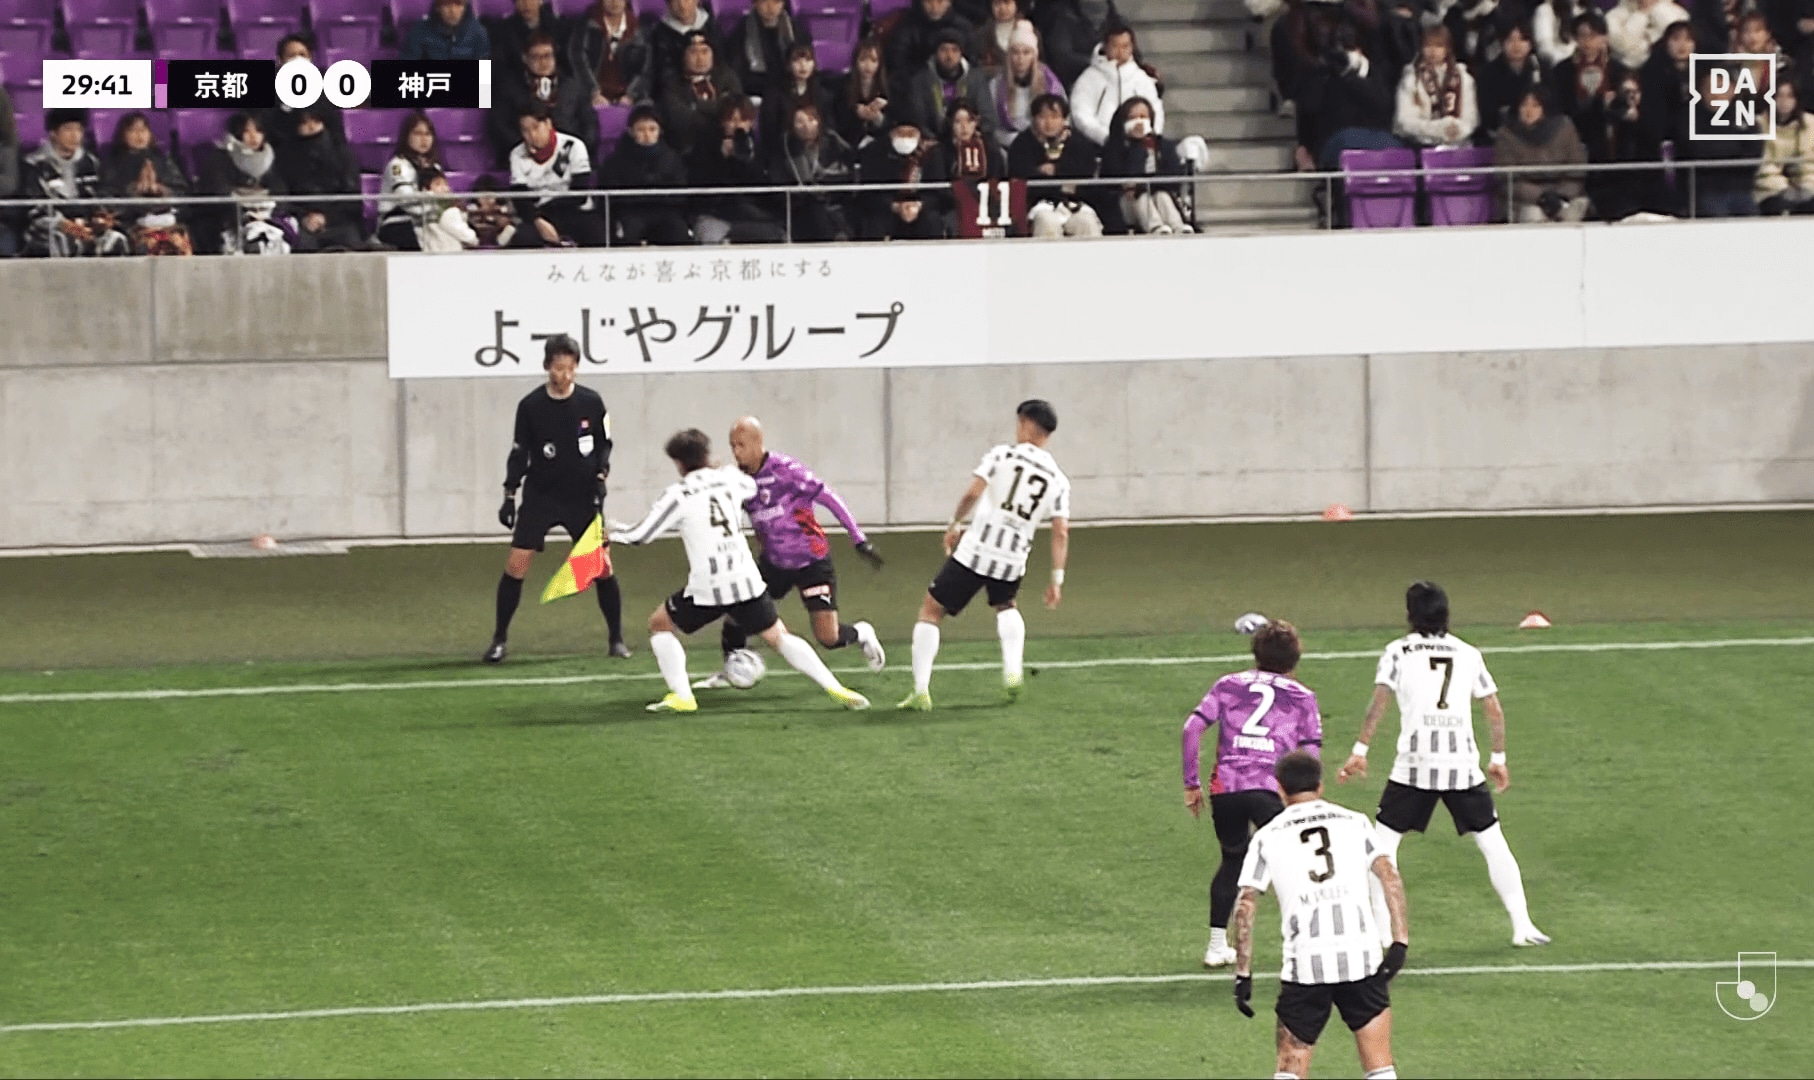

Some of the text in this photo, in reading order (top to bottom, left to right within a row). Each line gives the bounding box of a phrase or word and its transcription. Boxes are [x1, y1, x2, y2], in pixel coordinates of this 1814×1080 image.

[976, 182, 1012, 225] 11
[547, 258, 832, 284] みんなが喜ぶ京都にする
[474, 301, 904, 367] よーじやグループ
[709, 494, 733, 537] 4
[1001, 465, 1048, 520] 13
[1241, 683, 1275, 736] 2
[1429, 656, 1453, 710] 7
[1299, 825, 1336, 884] 3
